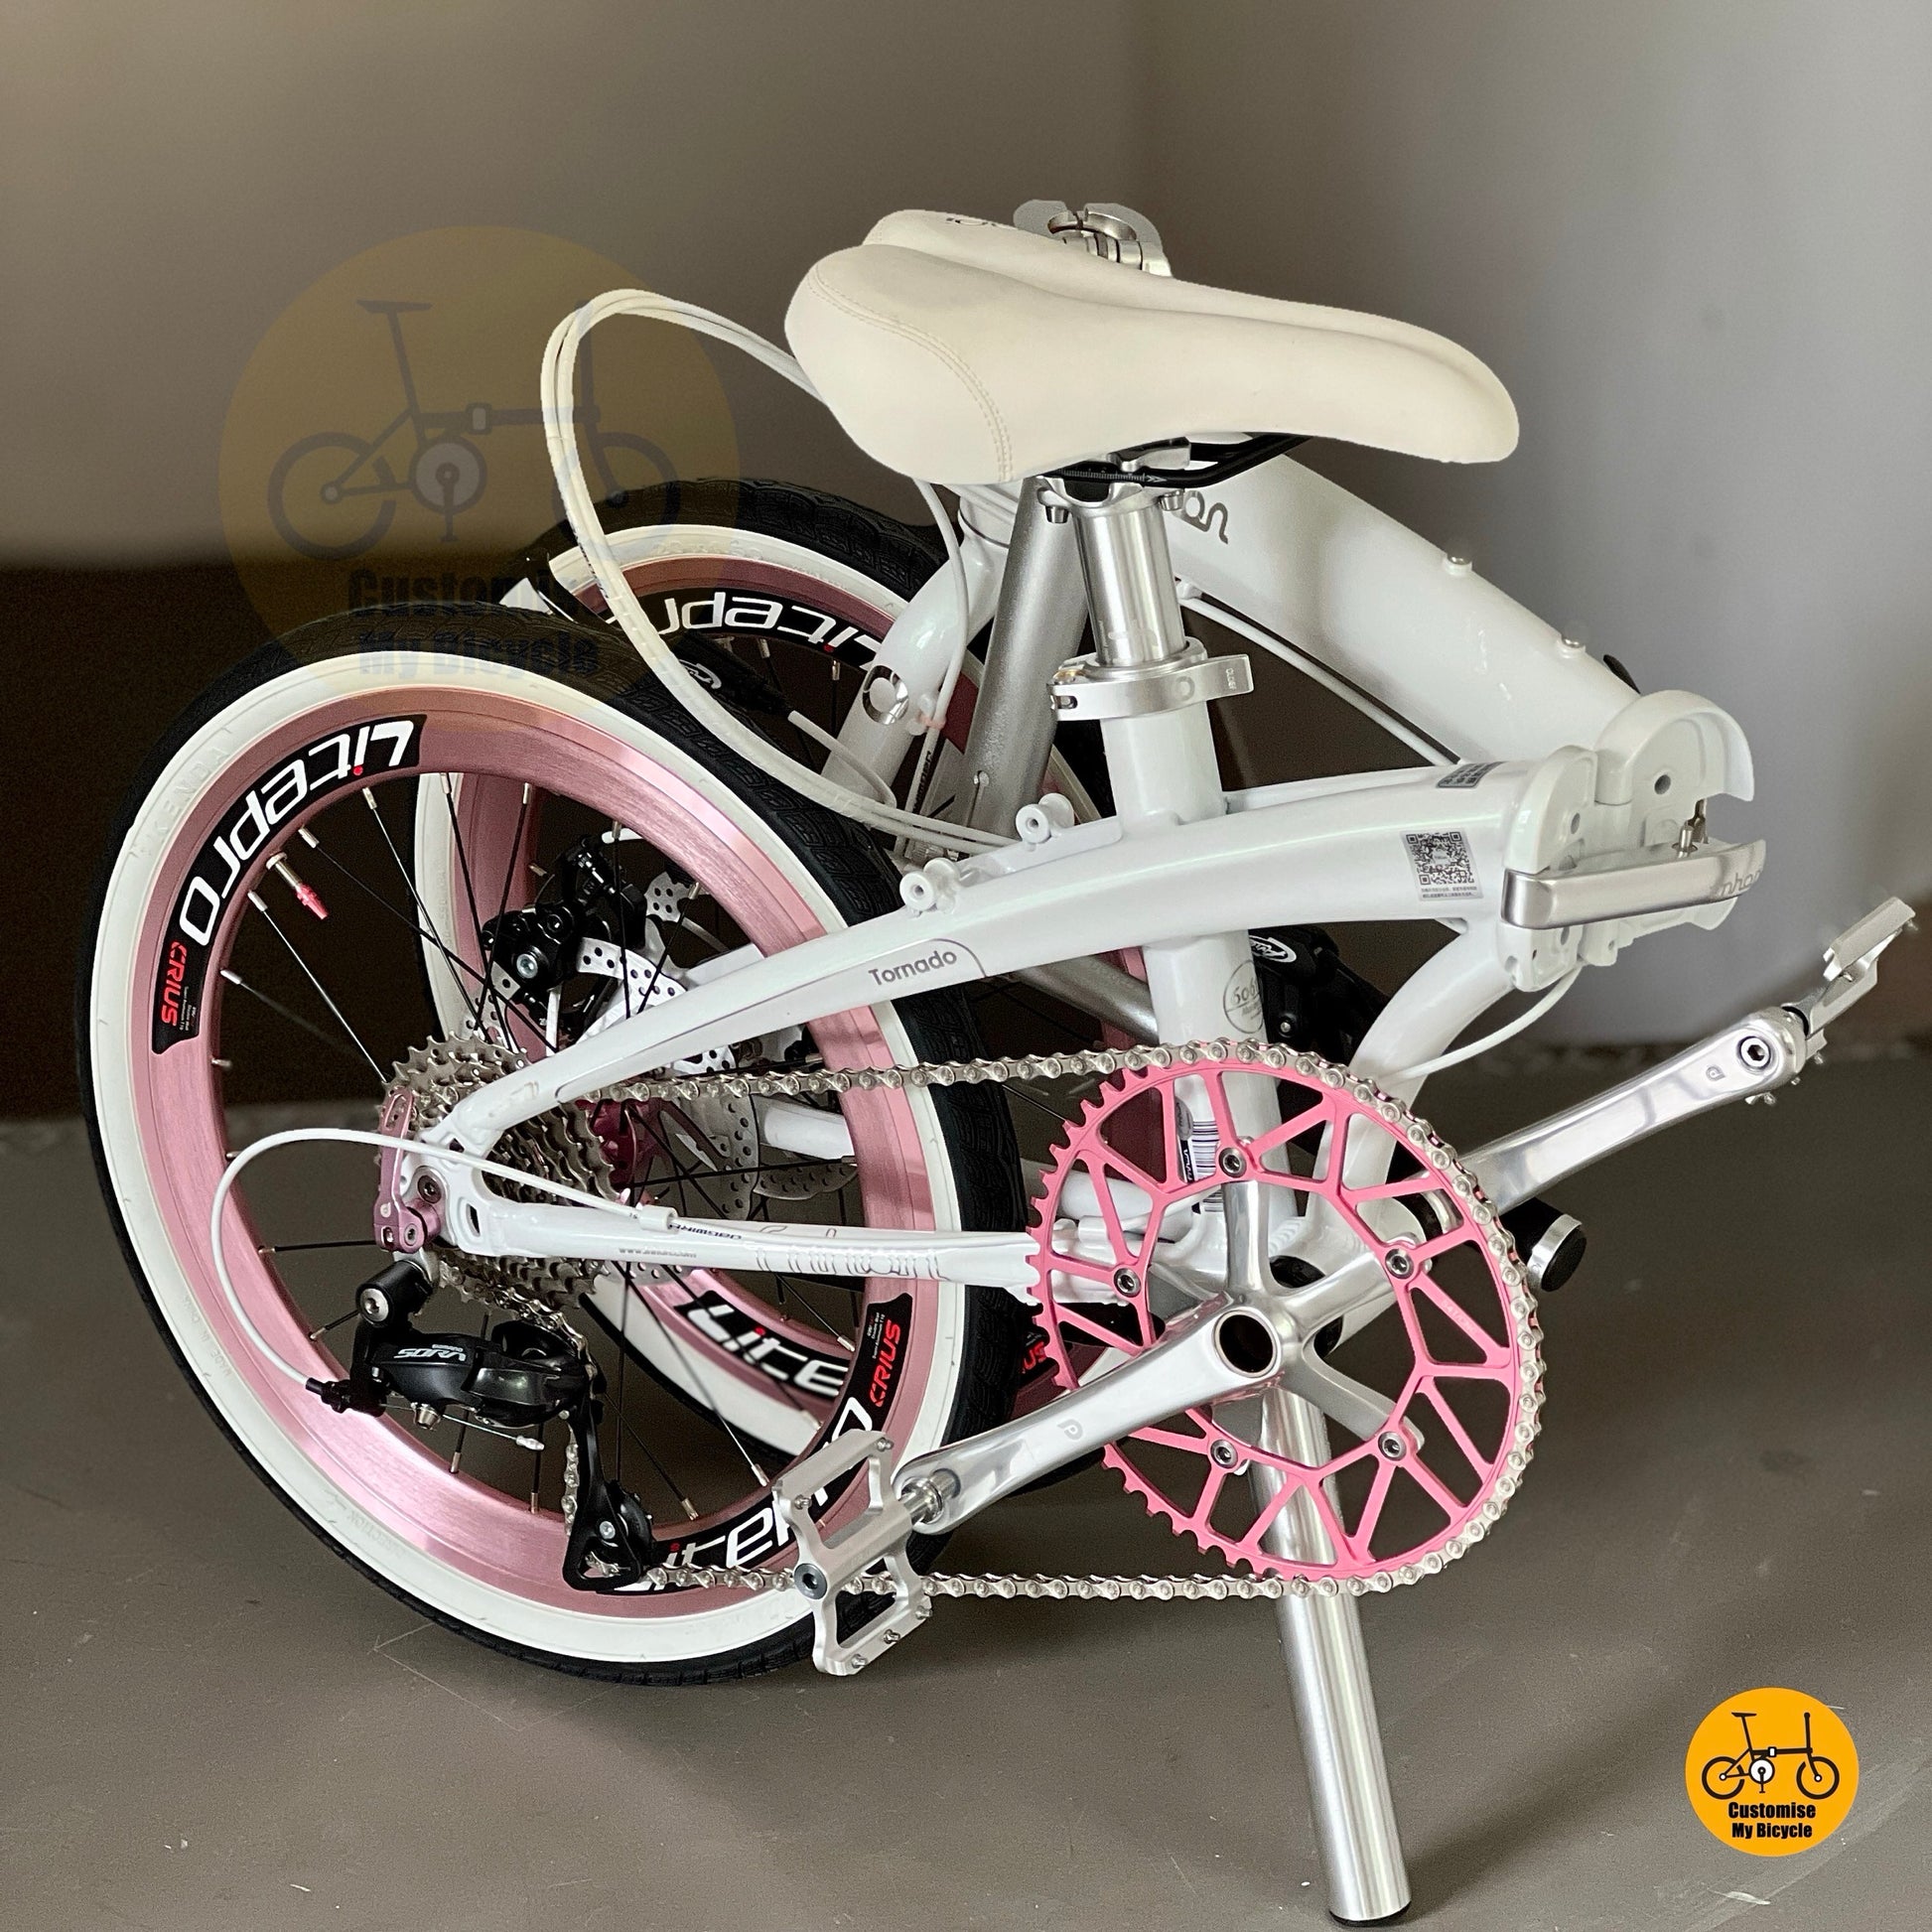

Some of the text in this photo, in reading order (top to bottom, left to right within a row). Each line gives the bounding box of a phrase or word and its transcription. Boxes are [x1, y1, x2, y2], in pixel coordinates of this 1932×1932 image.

[161, 941, 187, 1027] CRIUS
[868, 950, 957, 986] Tornado
[393, 1347, 467, 1362] SORA
[869, 1319, 901, 1408] CRIUS
